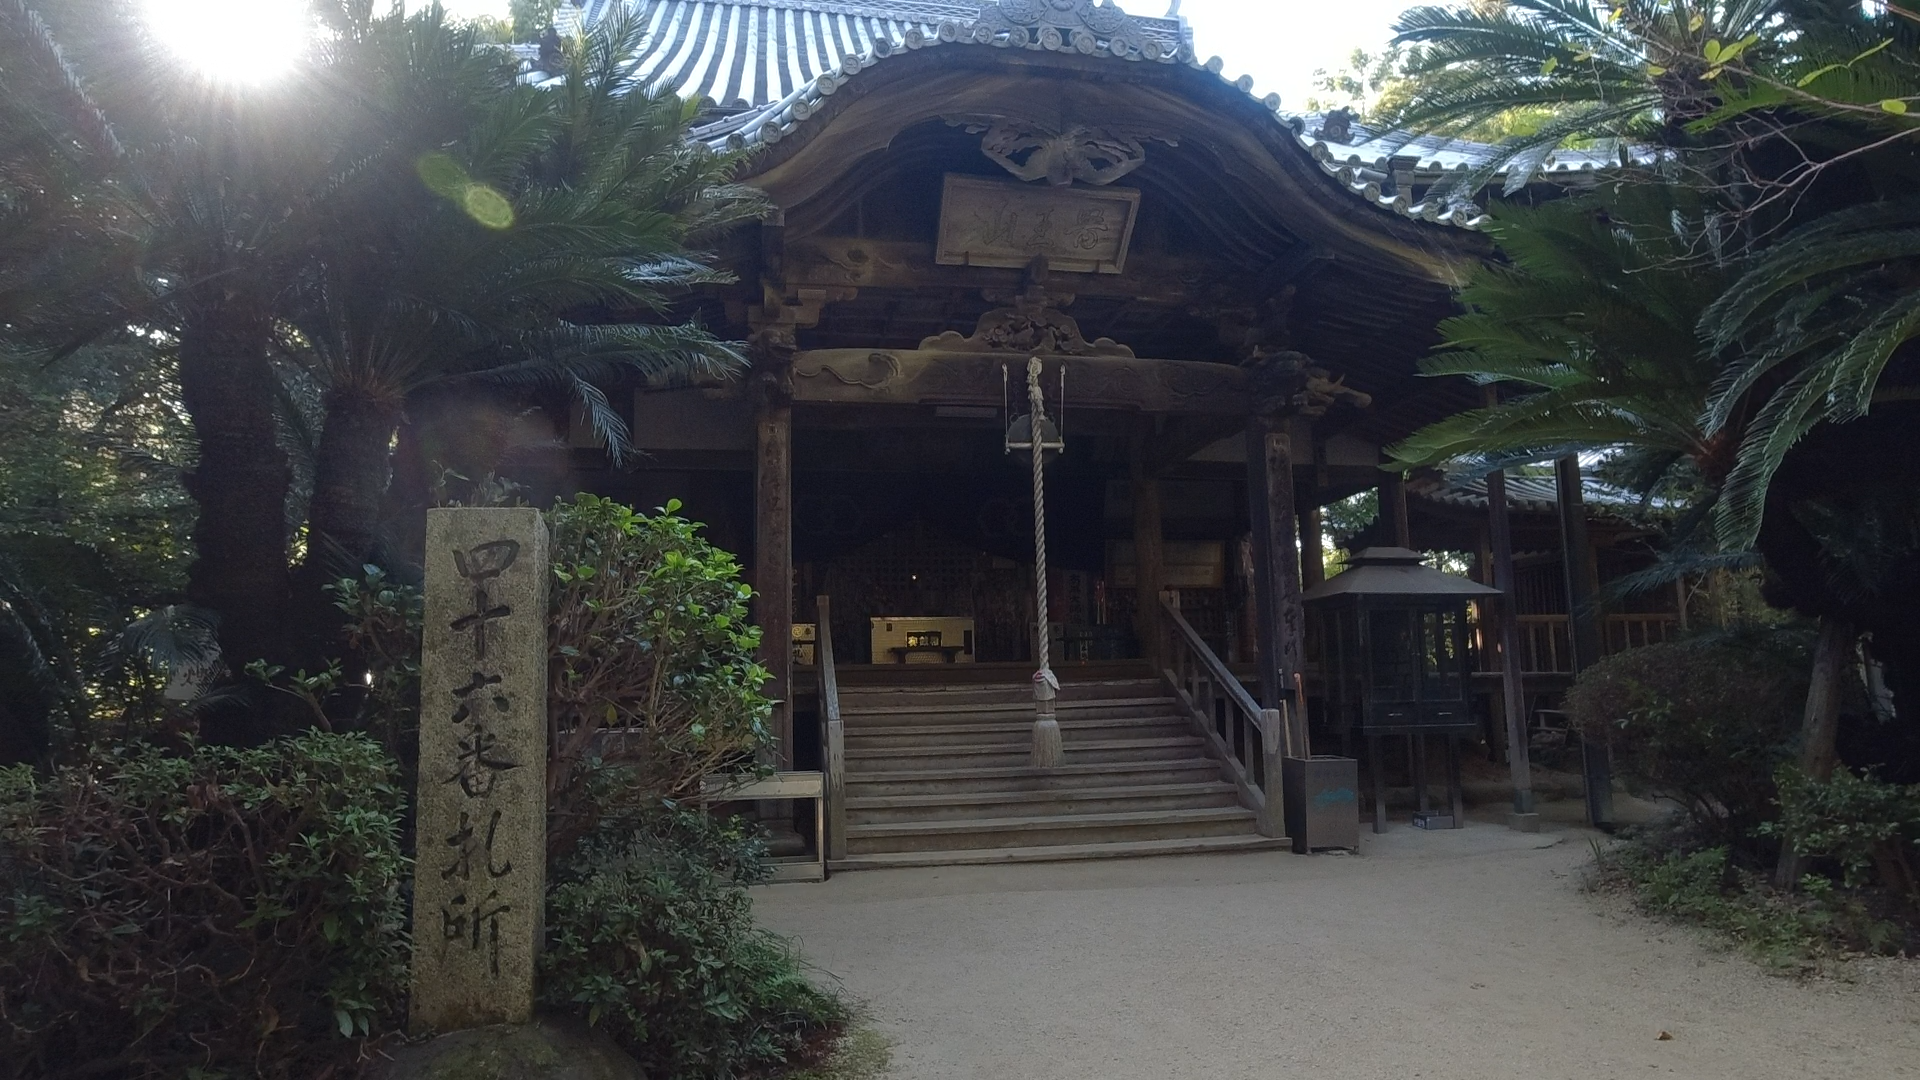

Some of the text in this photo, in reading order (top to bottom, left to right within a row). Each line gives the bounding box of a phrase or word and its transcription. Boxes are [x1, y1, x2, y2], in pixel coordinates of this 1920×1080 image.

[440, 539, 527, 977] 四十六番札所
